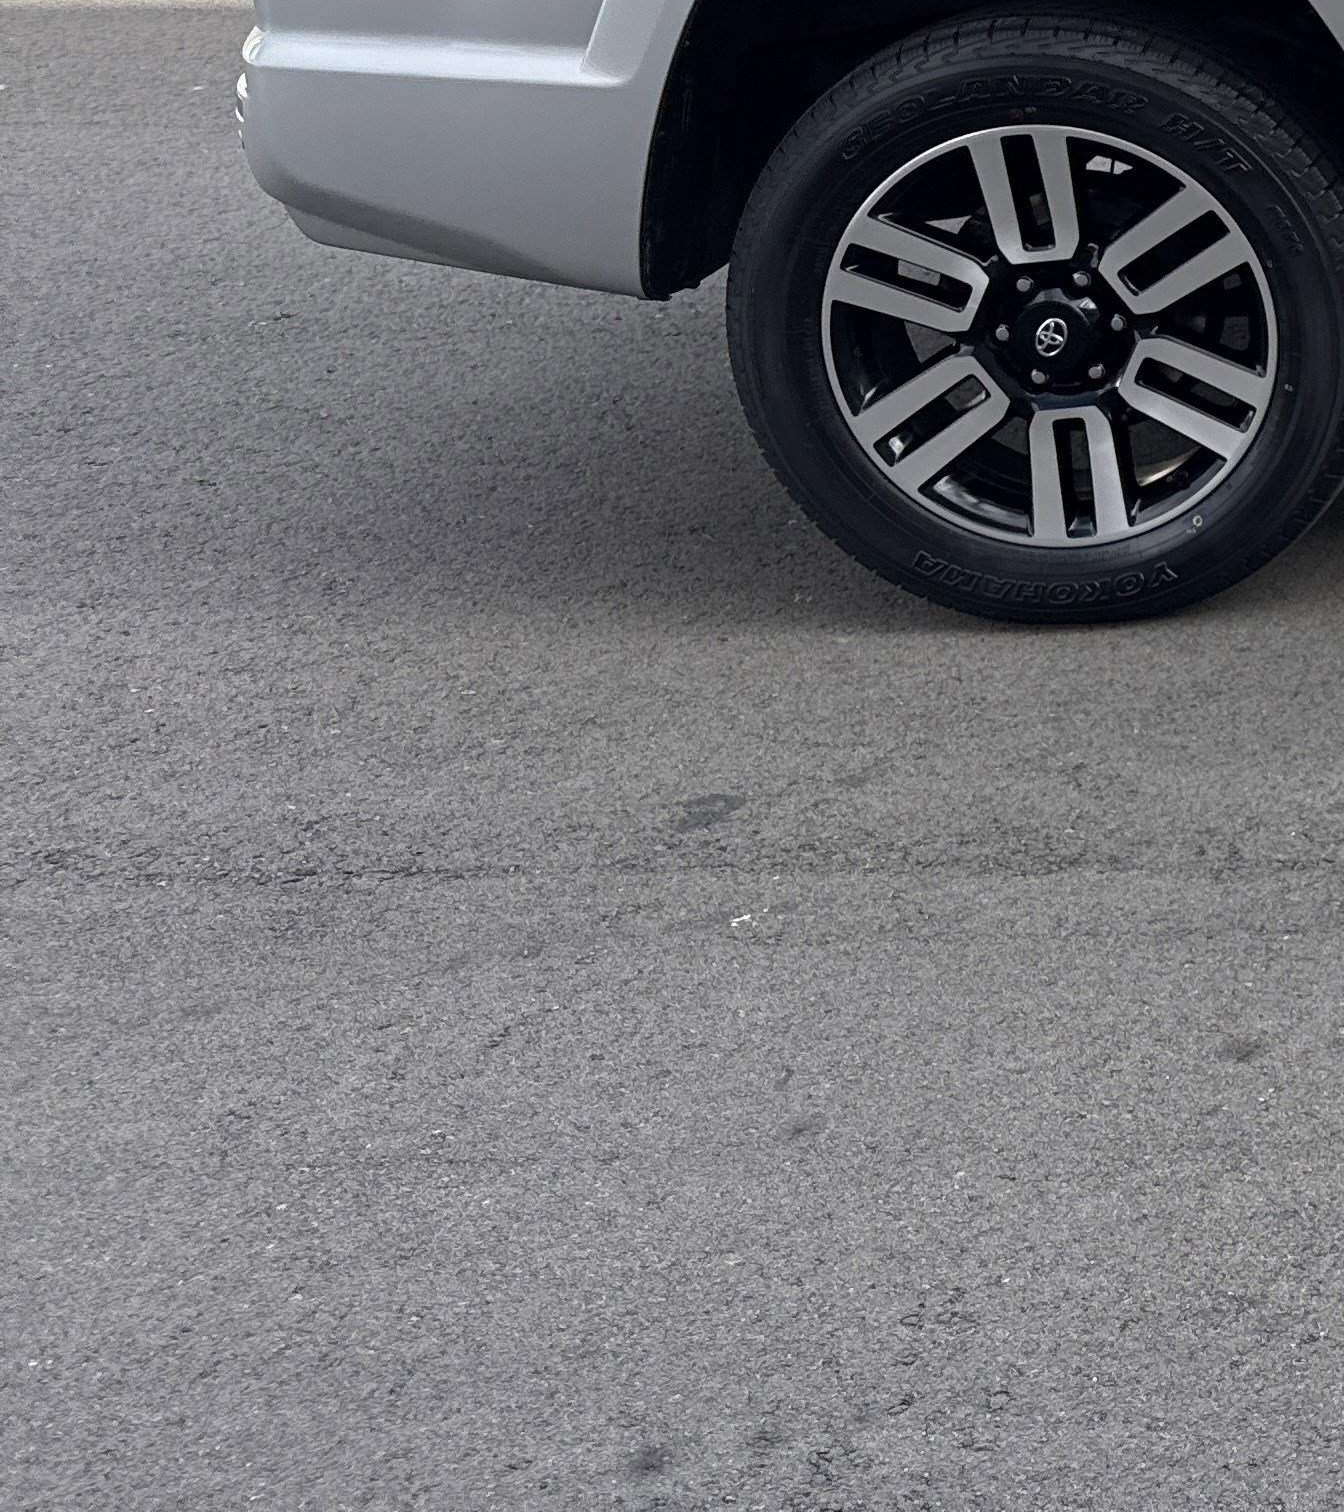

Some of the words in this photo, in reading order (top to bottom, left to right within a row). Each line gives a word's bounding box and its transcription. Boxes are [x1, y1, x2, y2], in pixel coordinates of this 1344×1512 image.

[837, 73, 1149, 160] GEOLANDAR
[1159, 111, 1253, 173] H/T
[911, 549, 1179, 605] YOKOHAMA
